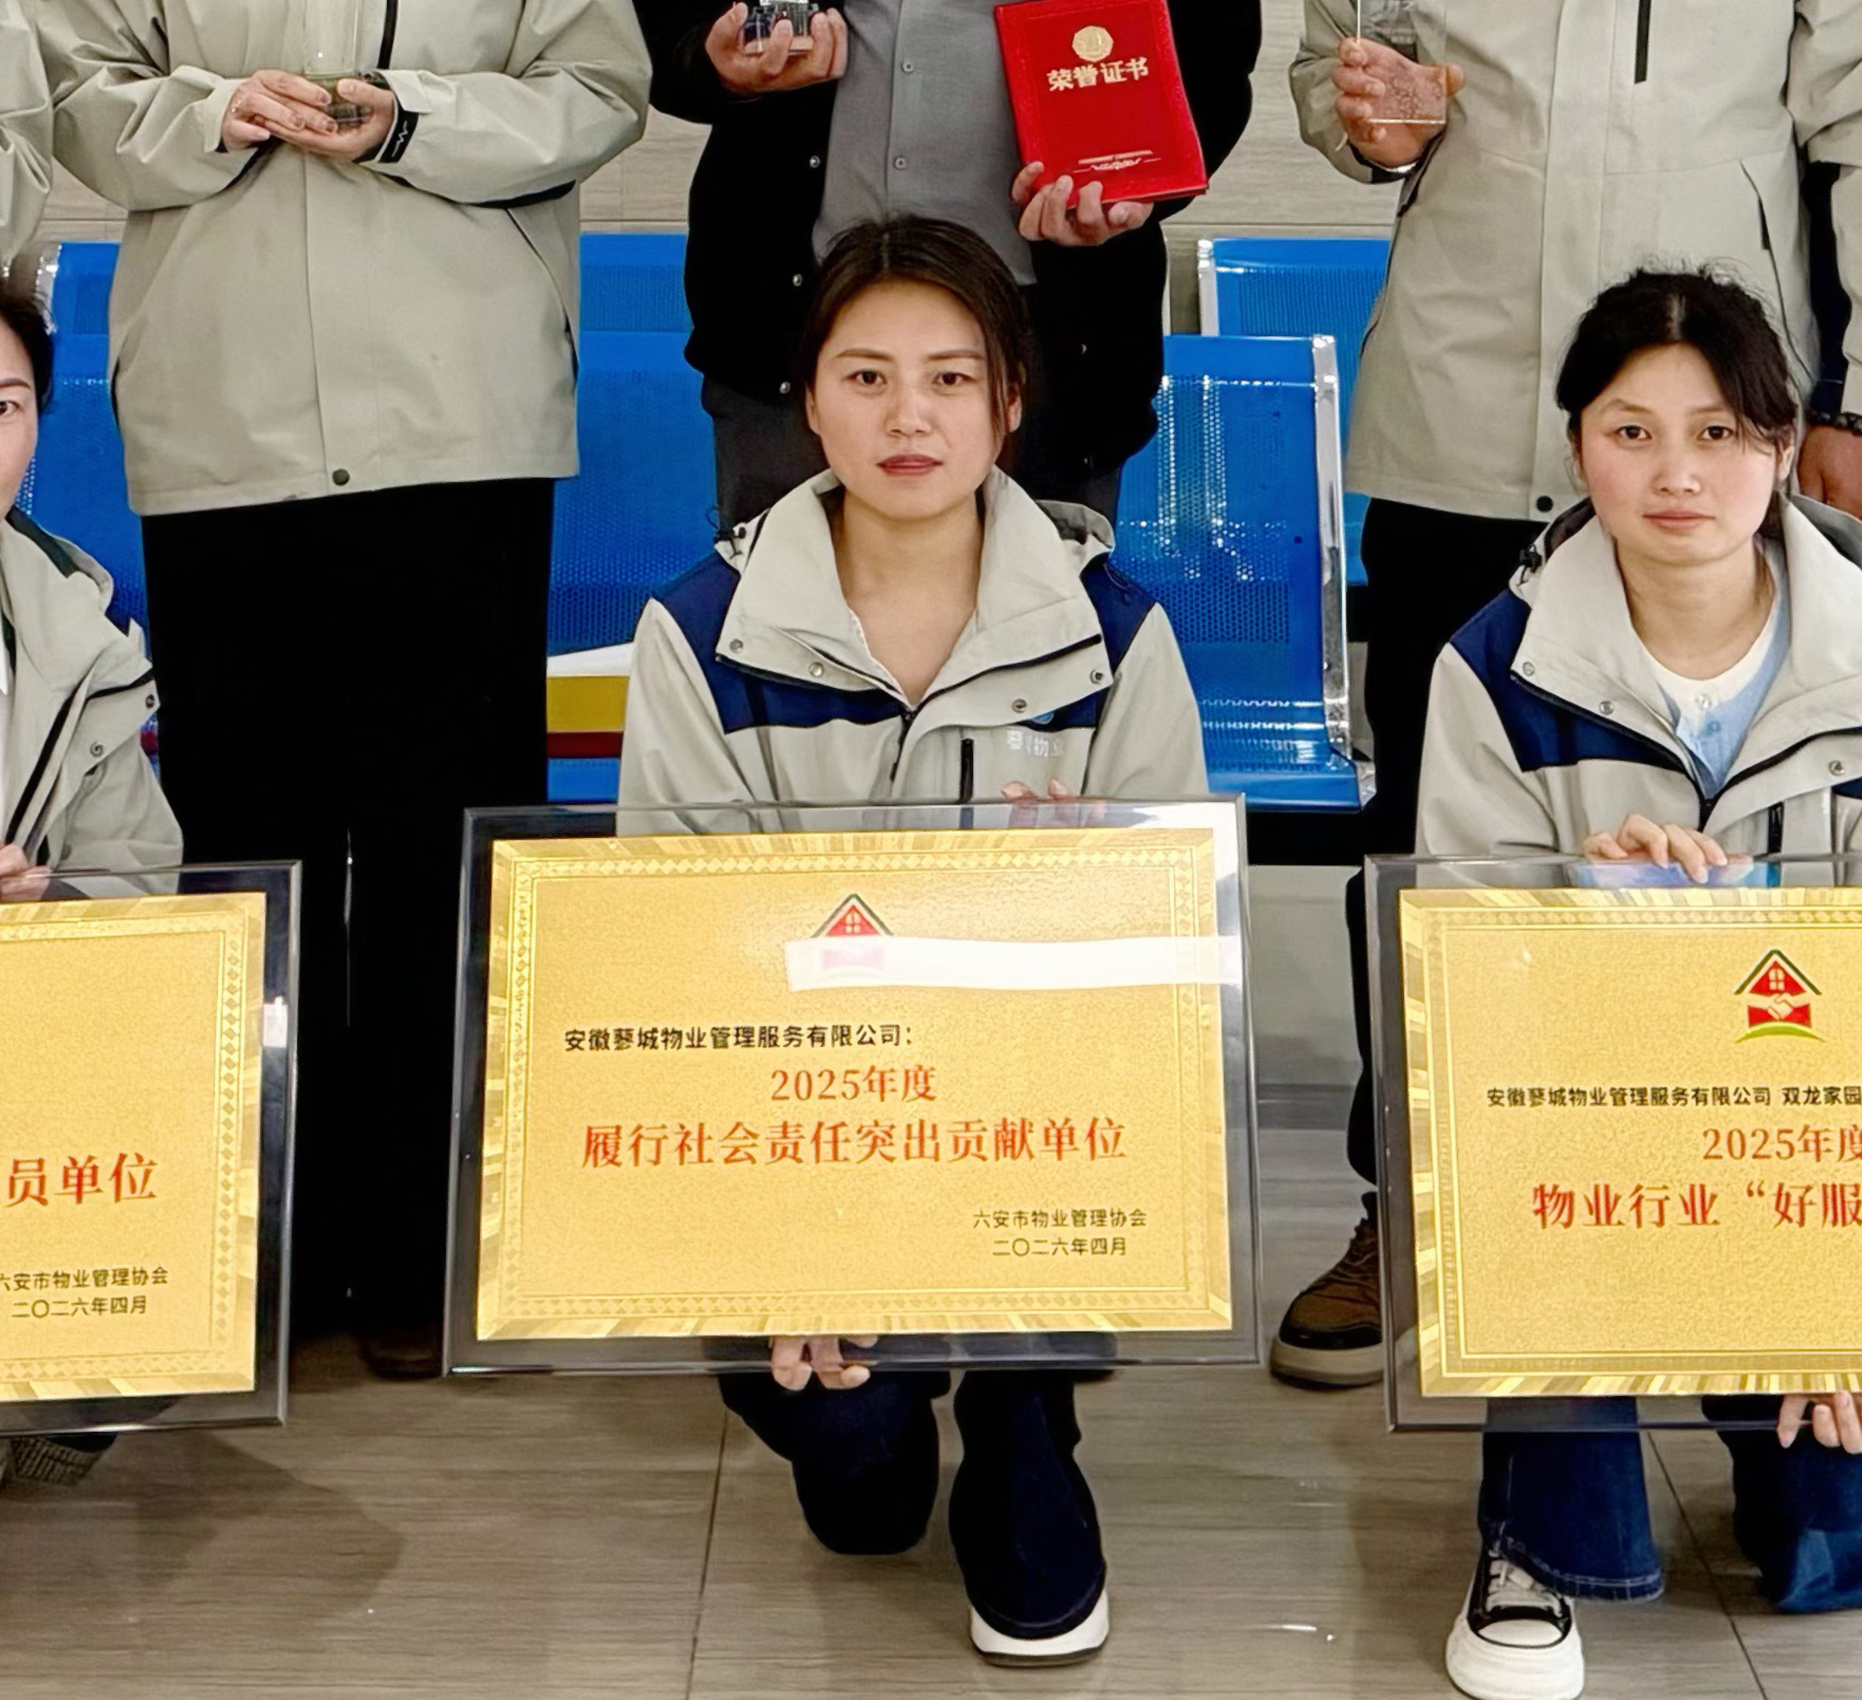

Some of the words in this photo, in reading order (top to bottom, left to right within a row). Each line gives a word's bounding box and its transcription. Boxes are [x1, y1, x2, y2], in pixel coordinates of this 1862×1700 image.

[1046, 56, 1149, 92] 荣誉证书
[770, 1064, 938, 1104] 2025年度
[581, 1115, 1128, 1170] 履行社会责任突出贡献单位
[972, 1207, 1149, 1231] 六安市物业管理协会
